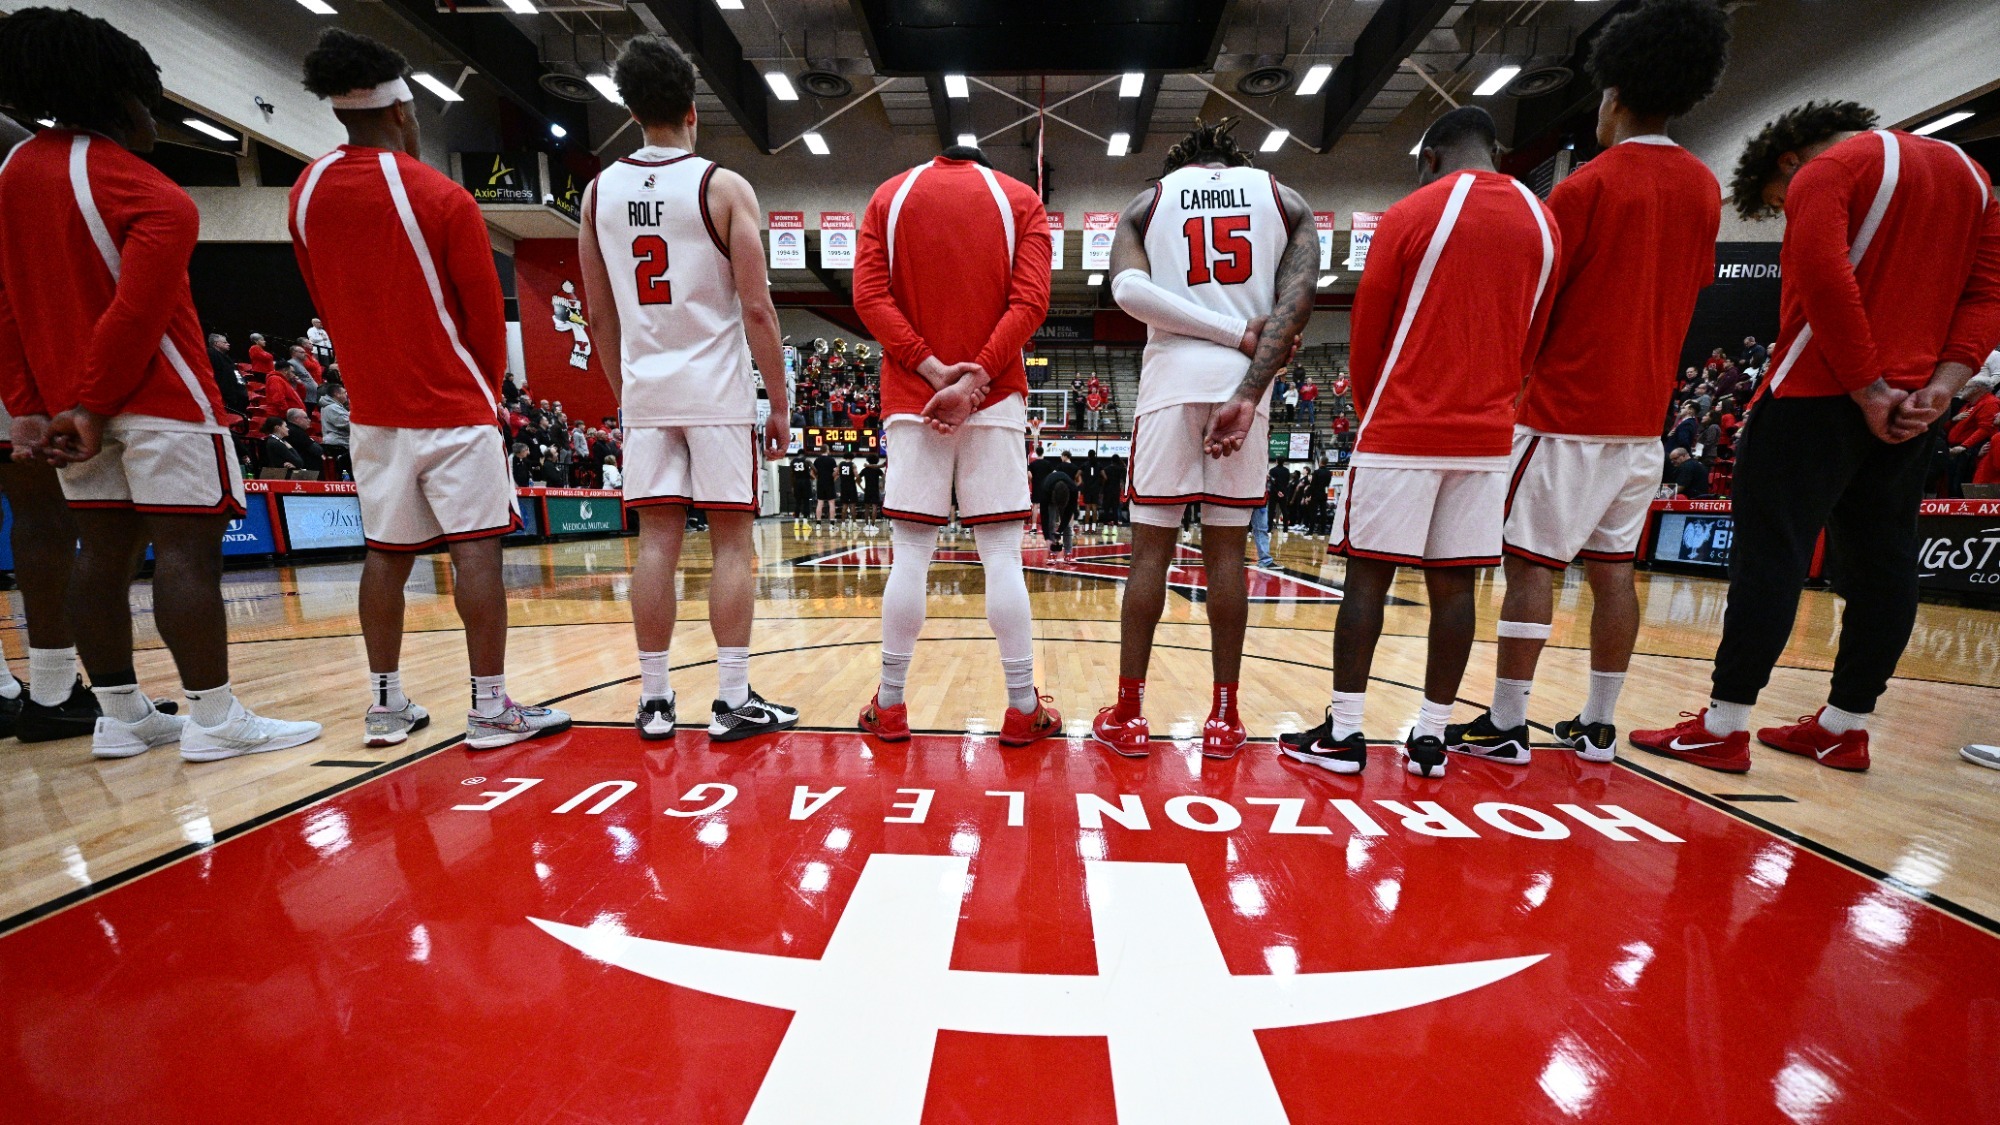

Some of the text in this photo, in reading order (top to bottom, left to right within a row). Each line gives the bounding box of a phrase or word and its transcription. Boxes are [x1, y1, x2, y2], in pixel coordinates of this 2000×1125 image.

[474, 188, 533, 198] AxioFitness
[1181, 188, 1251, 210] CARROLL
[628, 201, 664, 226] ROLF
[1183, 215, 1252, 286] 15
[632, 234, 672, 305] 2
[826, 430, 857, 441] 20:00
[816, 436, 822, 446] 0
[869, 436, 876, 447] 0
[794, 462, 805, 471] 33
[842, 466, 850, 475] 21
[1690, 502, 1725, 510] STRETCH
[1919, 503, 1950, 513] COM
[562, 521, 610, 531] MEDICAL MUTUAL
[1075, 793, 1687, 842] HORIZON
